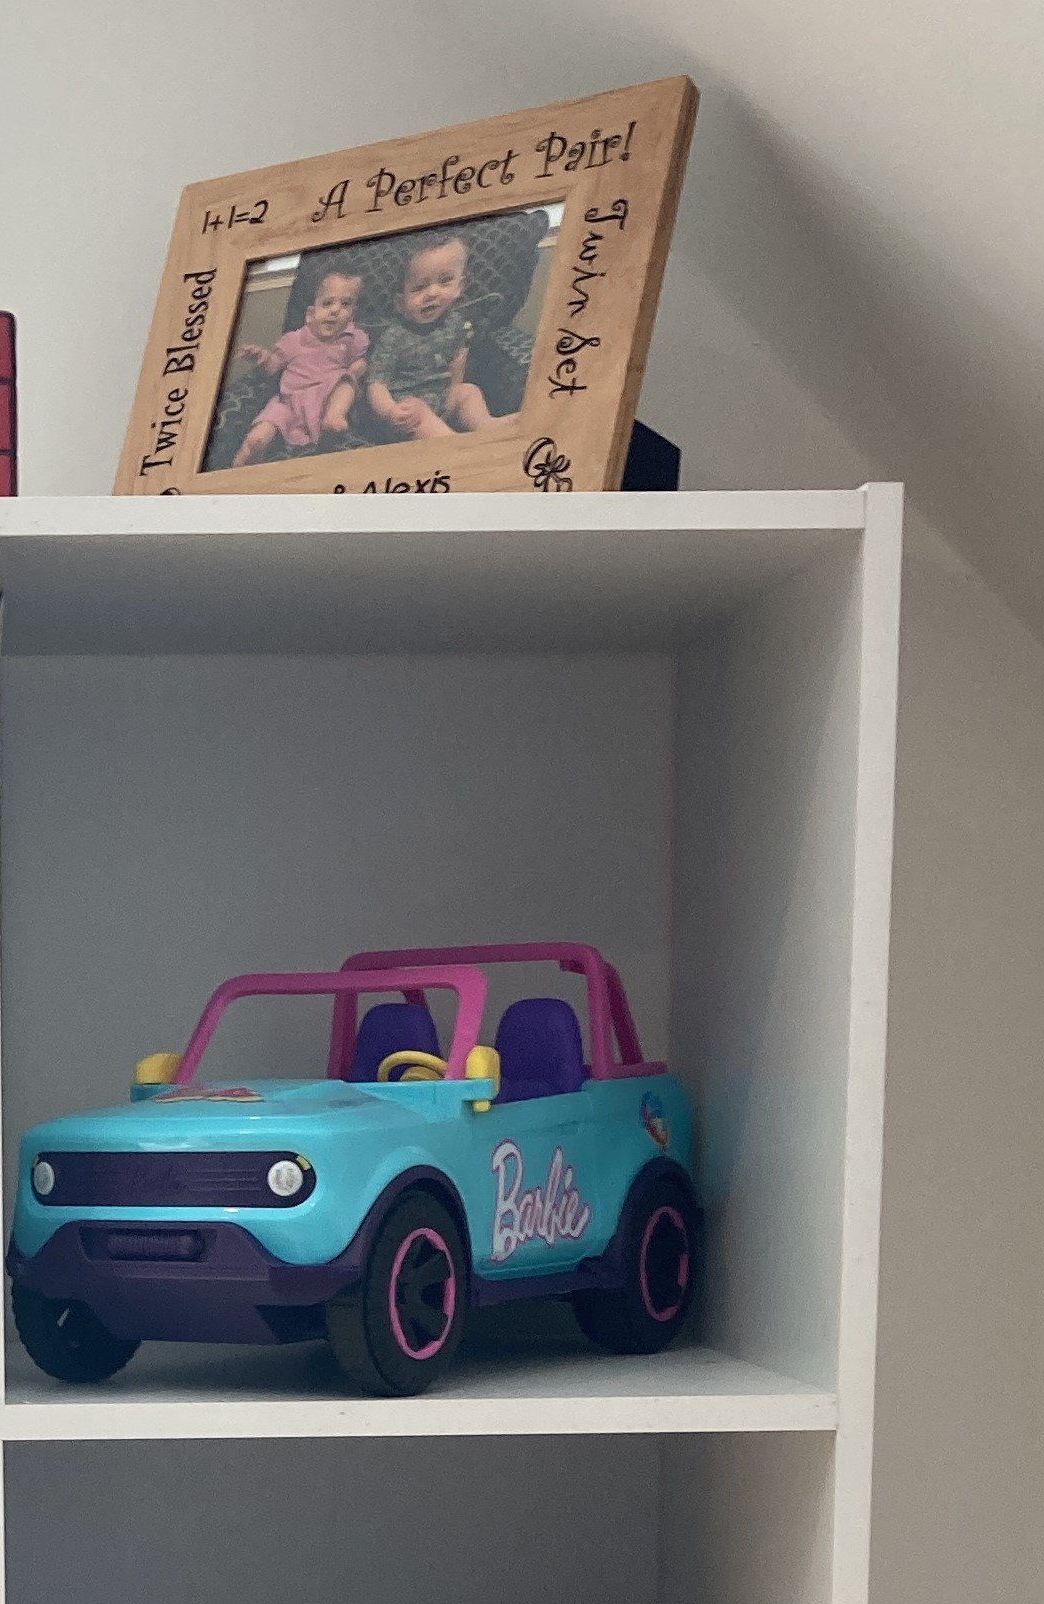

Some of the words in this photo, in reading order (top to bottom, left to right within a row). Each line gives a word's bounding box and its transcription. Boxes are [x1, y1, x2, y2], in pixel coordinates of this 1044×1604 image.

[201, 200, 270, 233] 1+1=2
[311, 179, 350, 223] A
[365, 149, 522, 213] Perfect
[534, 121, 637, 179] Pair!
[568, 198, 629, 317] Twin
[163, 268, 218, 376] Blessed
[548, 328, 601, 399] Set
[139, 387, 189, 477] Twice
[491, 1139, 591, 1262] Barbie
